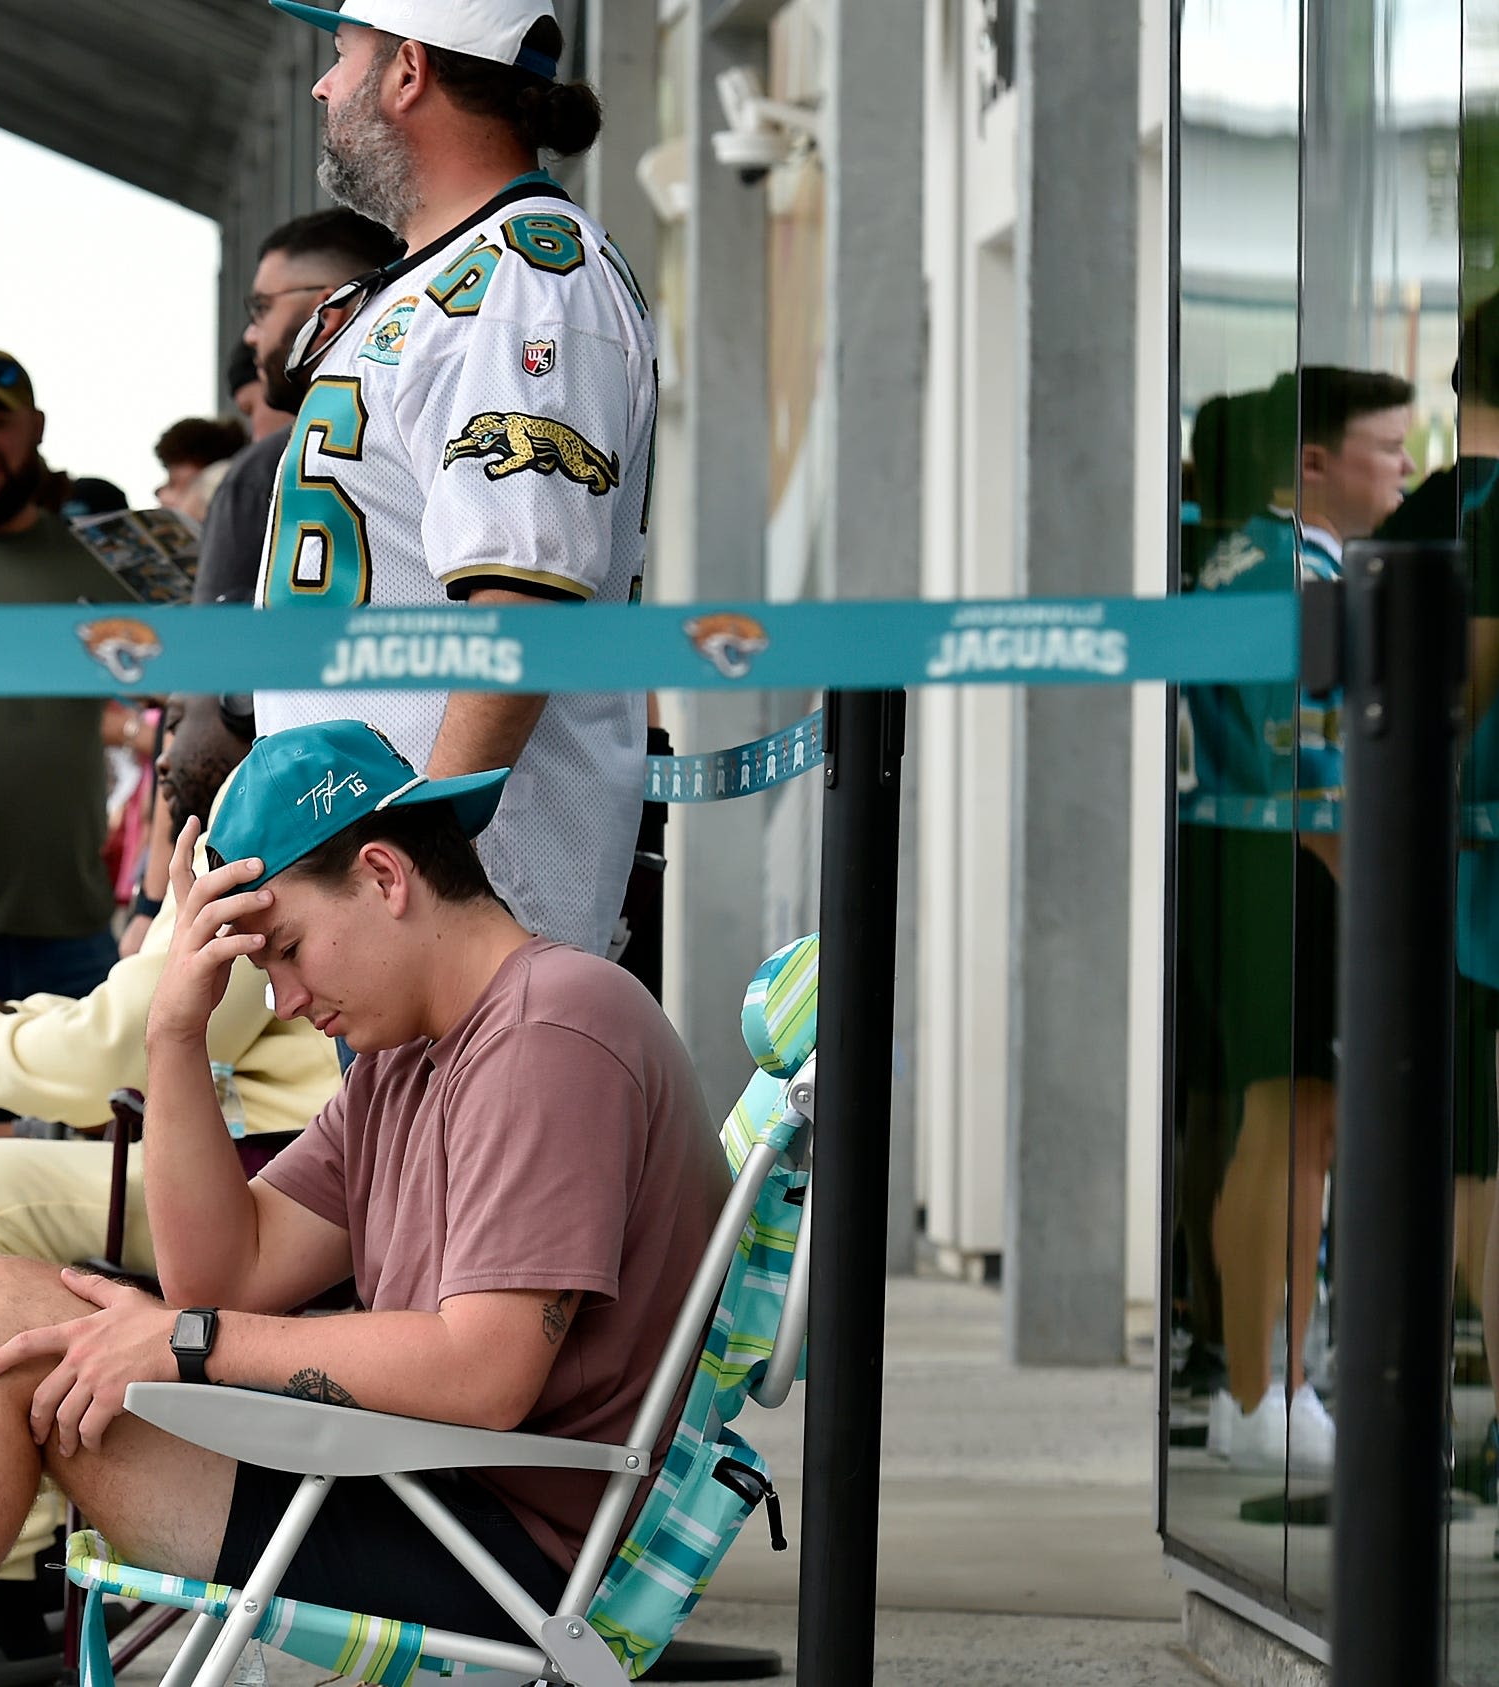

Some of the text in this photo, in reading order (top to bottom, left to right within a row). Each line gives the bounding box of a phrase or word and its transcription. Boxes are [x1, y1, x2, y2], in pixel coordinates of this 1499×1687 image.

[321, 634, 523, 685] JAGUARS
[926, 626, 1128, 677] JAGUARS
[348, 778, 368, 798] 16
